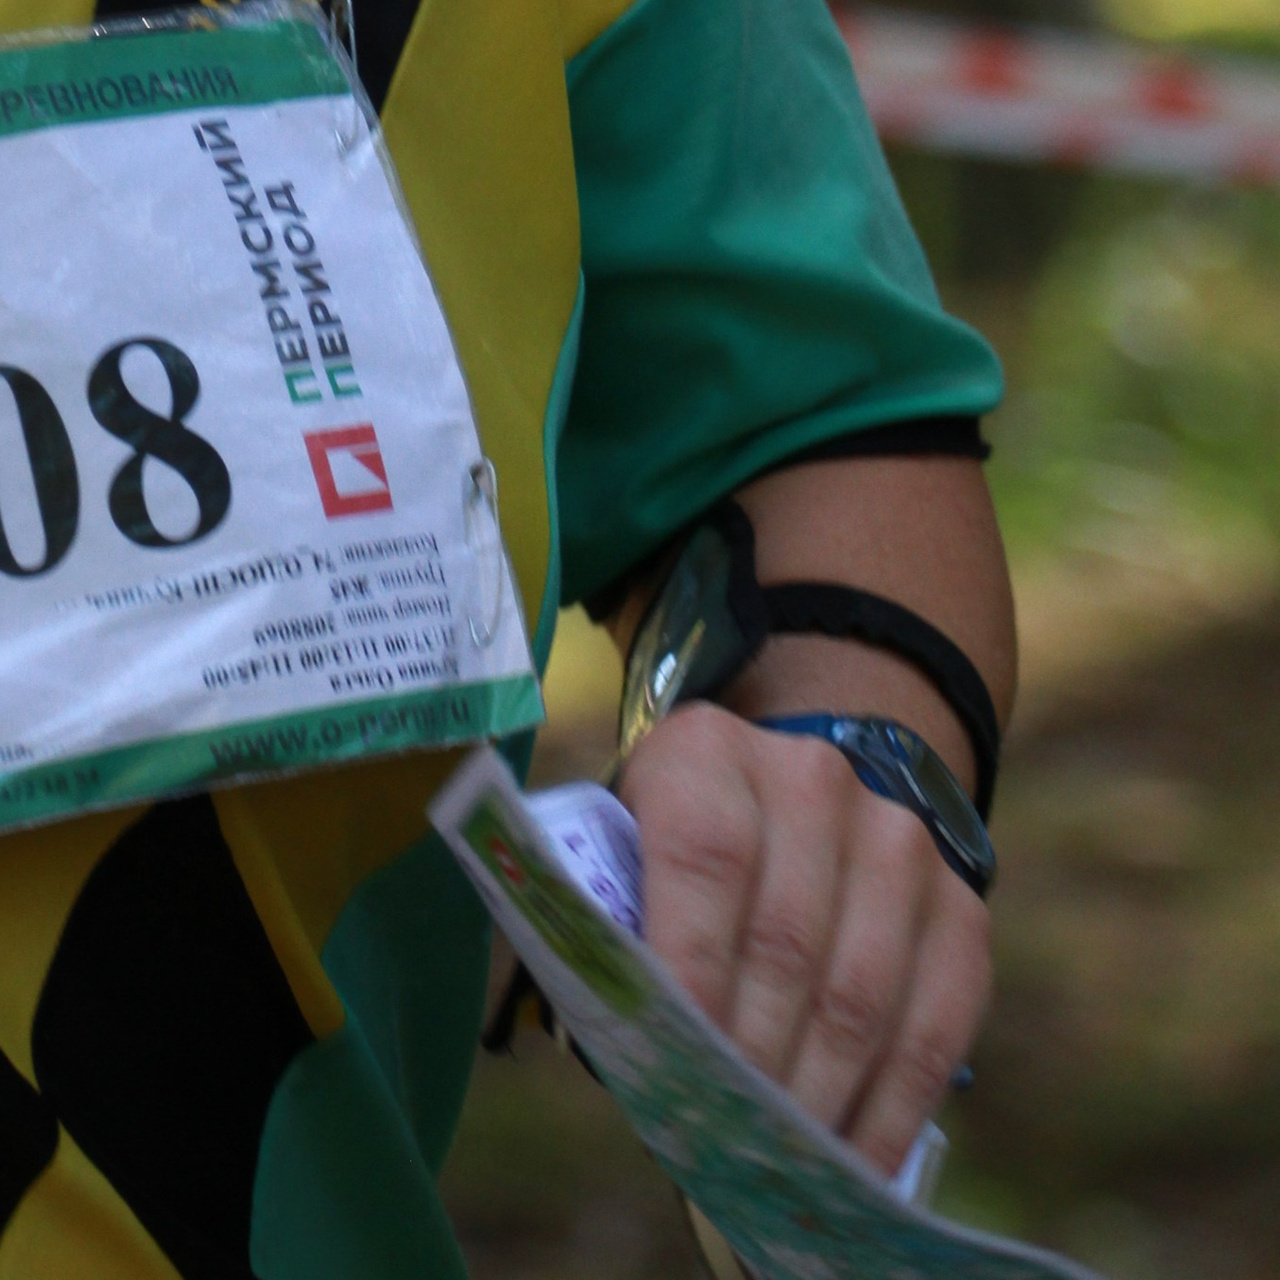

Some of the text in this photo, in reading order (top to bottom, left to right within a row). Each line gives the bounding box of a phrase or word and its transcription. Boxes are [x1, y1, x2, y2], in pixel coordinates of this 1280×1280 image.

[191, 117, 324, 407] ПЕРМСКИЙ
[264, 179, 364, 401] ПЕРИОД
[254, 611, 335, 648] 2088069
[329, 665, 394, 694] Ольга
